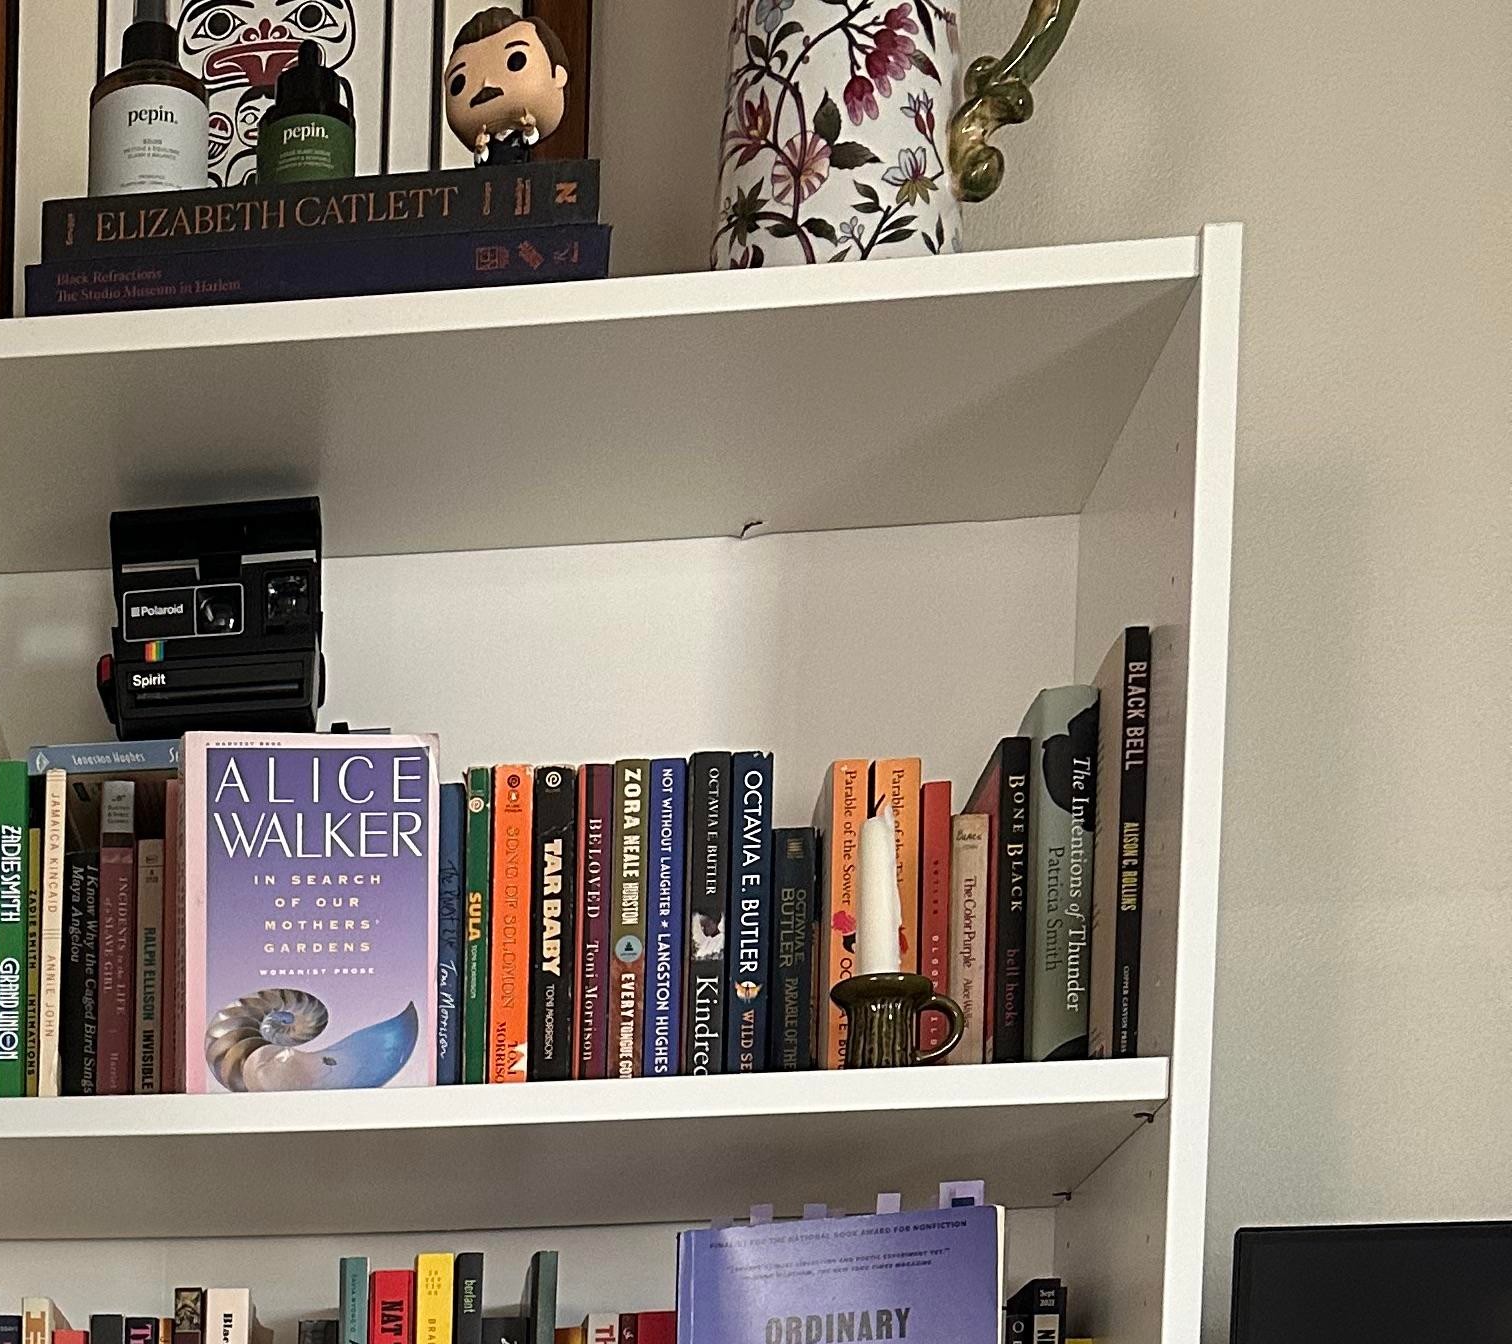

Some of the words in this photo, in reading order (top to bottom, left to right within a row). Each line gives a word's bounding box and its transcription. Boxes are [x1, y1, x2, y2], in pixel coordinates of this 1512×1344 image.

[95, 200, 285, 242] ELIZABETH
[294, 186, 459, 226] CATLETT
[141, 604, 183, 617] Polaroid
[132, 673, 166, 687] Spirit
[1127, 662, 1147, 720] BLACK
[1126, 727, 1144, 771] BELL
[214, 756, 422, 803] ALICE
[1007, 775, 1024, 833] BONE
[49, 793, 58, 853] JAMAICA
[214, 812, 423, 858] WALKER
[744, 771, 762, 866] OCTAVIA
[49, 858, 58, 913] KINCAID
[254, 874, 275, 885] IN
[292, 873, 382, 885] SEARCH
[544, 839, 562, 895] TAR
[1007, 844, 1024, 912] BLACK
[1048, 846, 1064, 913] Patricia
[275, 897, 300, 908] OF
[316, 897, 359, 908] OUR
[264, 941, 370, 953] GARDENS
[542, 900, 561, 977] BABY
[740, 899, 759, 973] BUTLER
[1045, 920, 1063, 971] Smith
[47, 955, 55, 1004] ANNIE
[657, 933, 670, 1011] LANGSTON
[46, 1007, 54, 1037] JOHN
[655, 1017, 669, 1072] HUGHES
